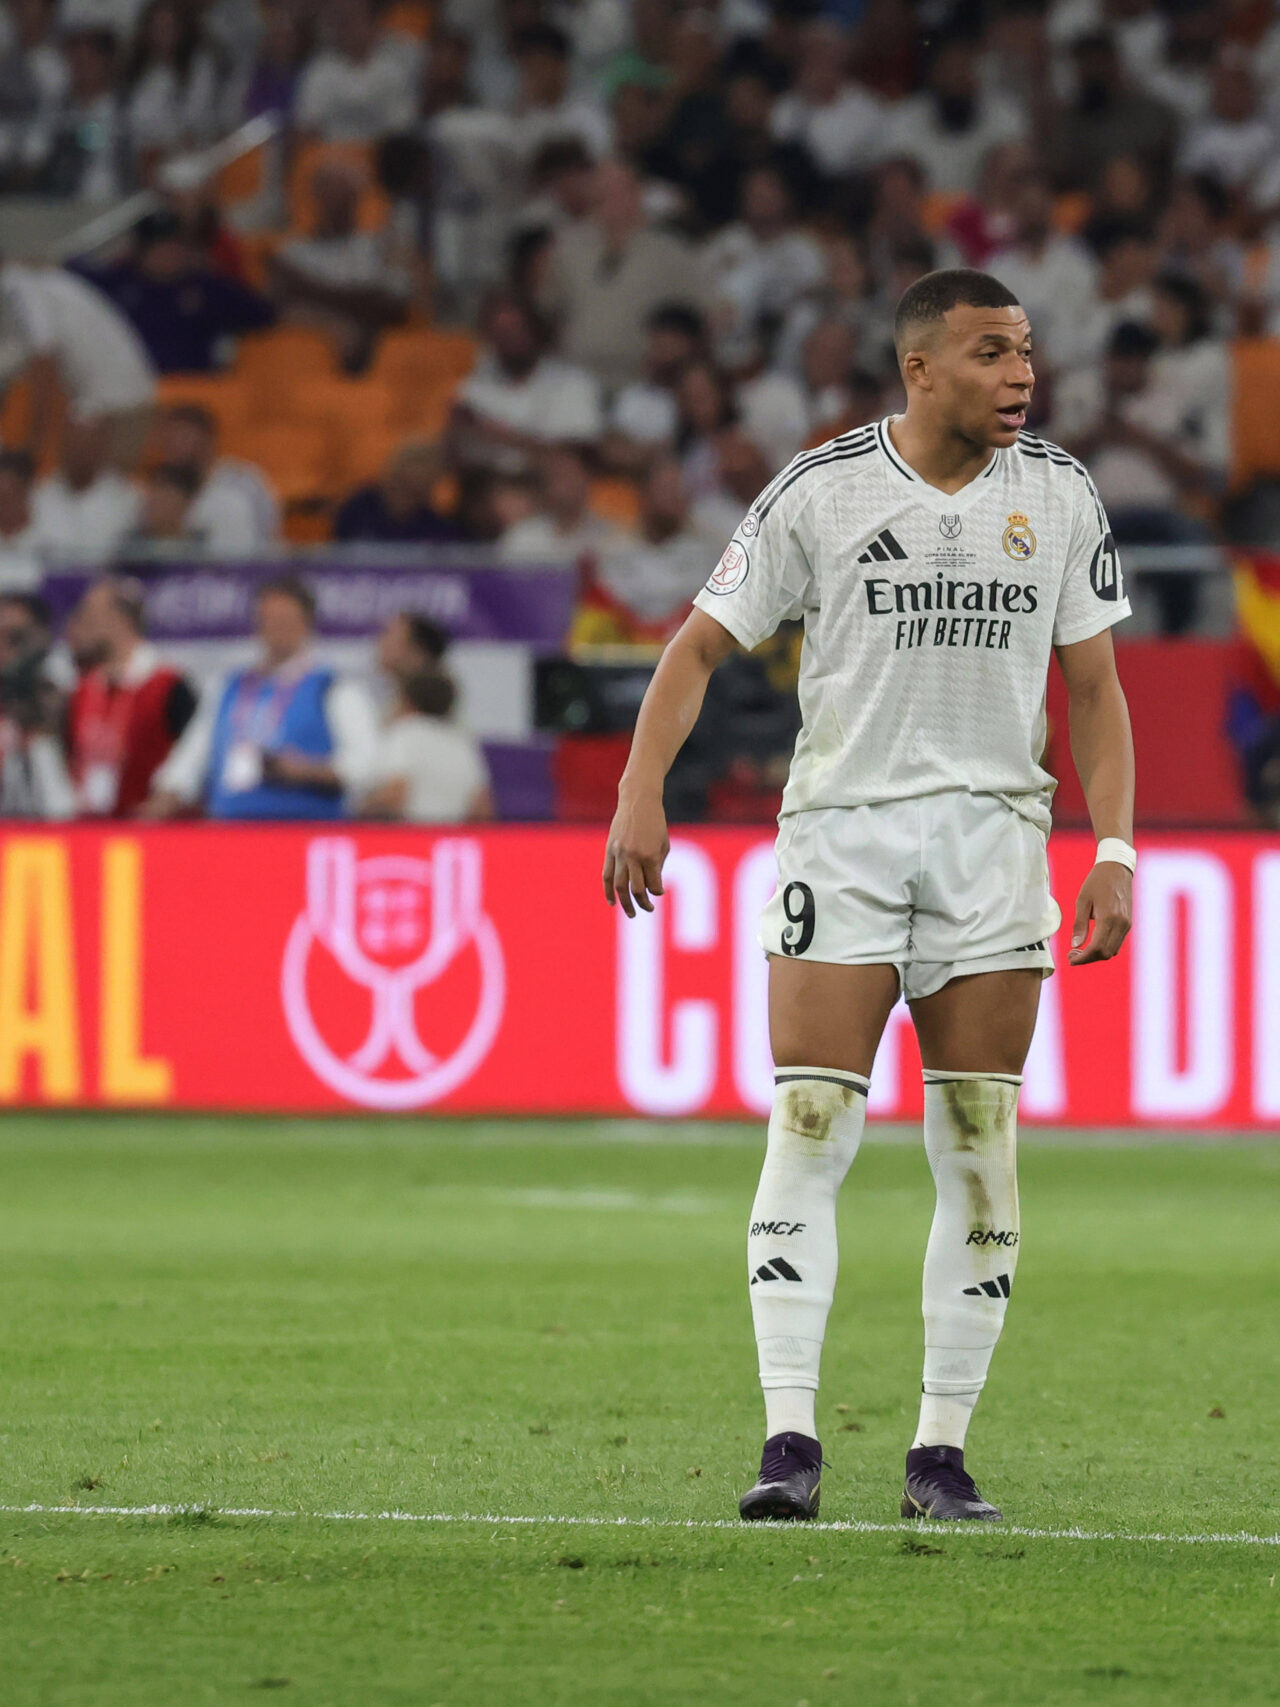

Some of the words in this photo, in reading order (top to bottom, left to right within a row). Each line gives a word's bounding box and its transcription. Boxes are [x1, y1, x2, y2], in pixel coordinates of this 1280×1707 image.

[863, 572, 1038, 615] Emirates
[895, 618, 928, 650] FLY
[933, 617, 1011, 650] BETTER
[781, 881, 816, 957] 9
[750, 1221, 806, 1237] RMCF
